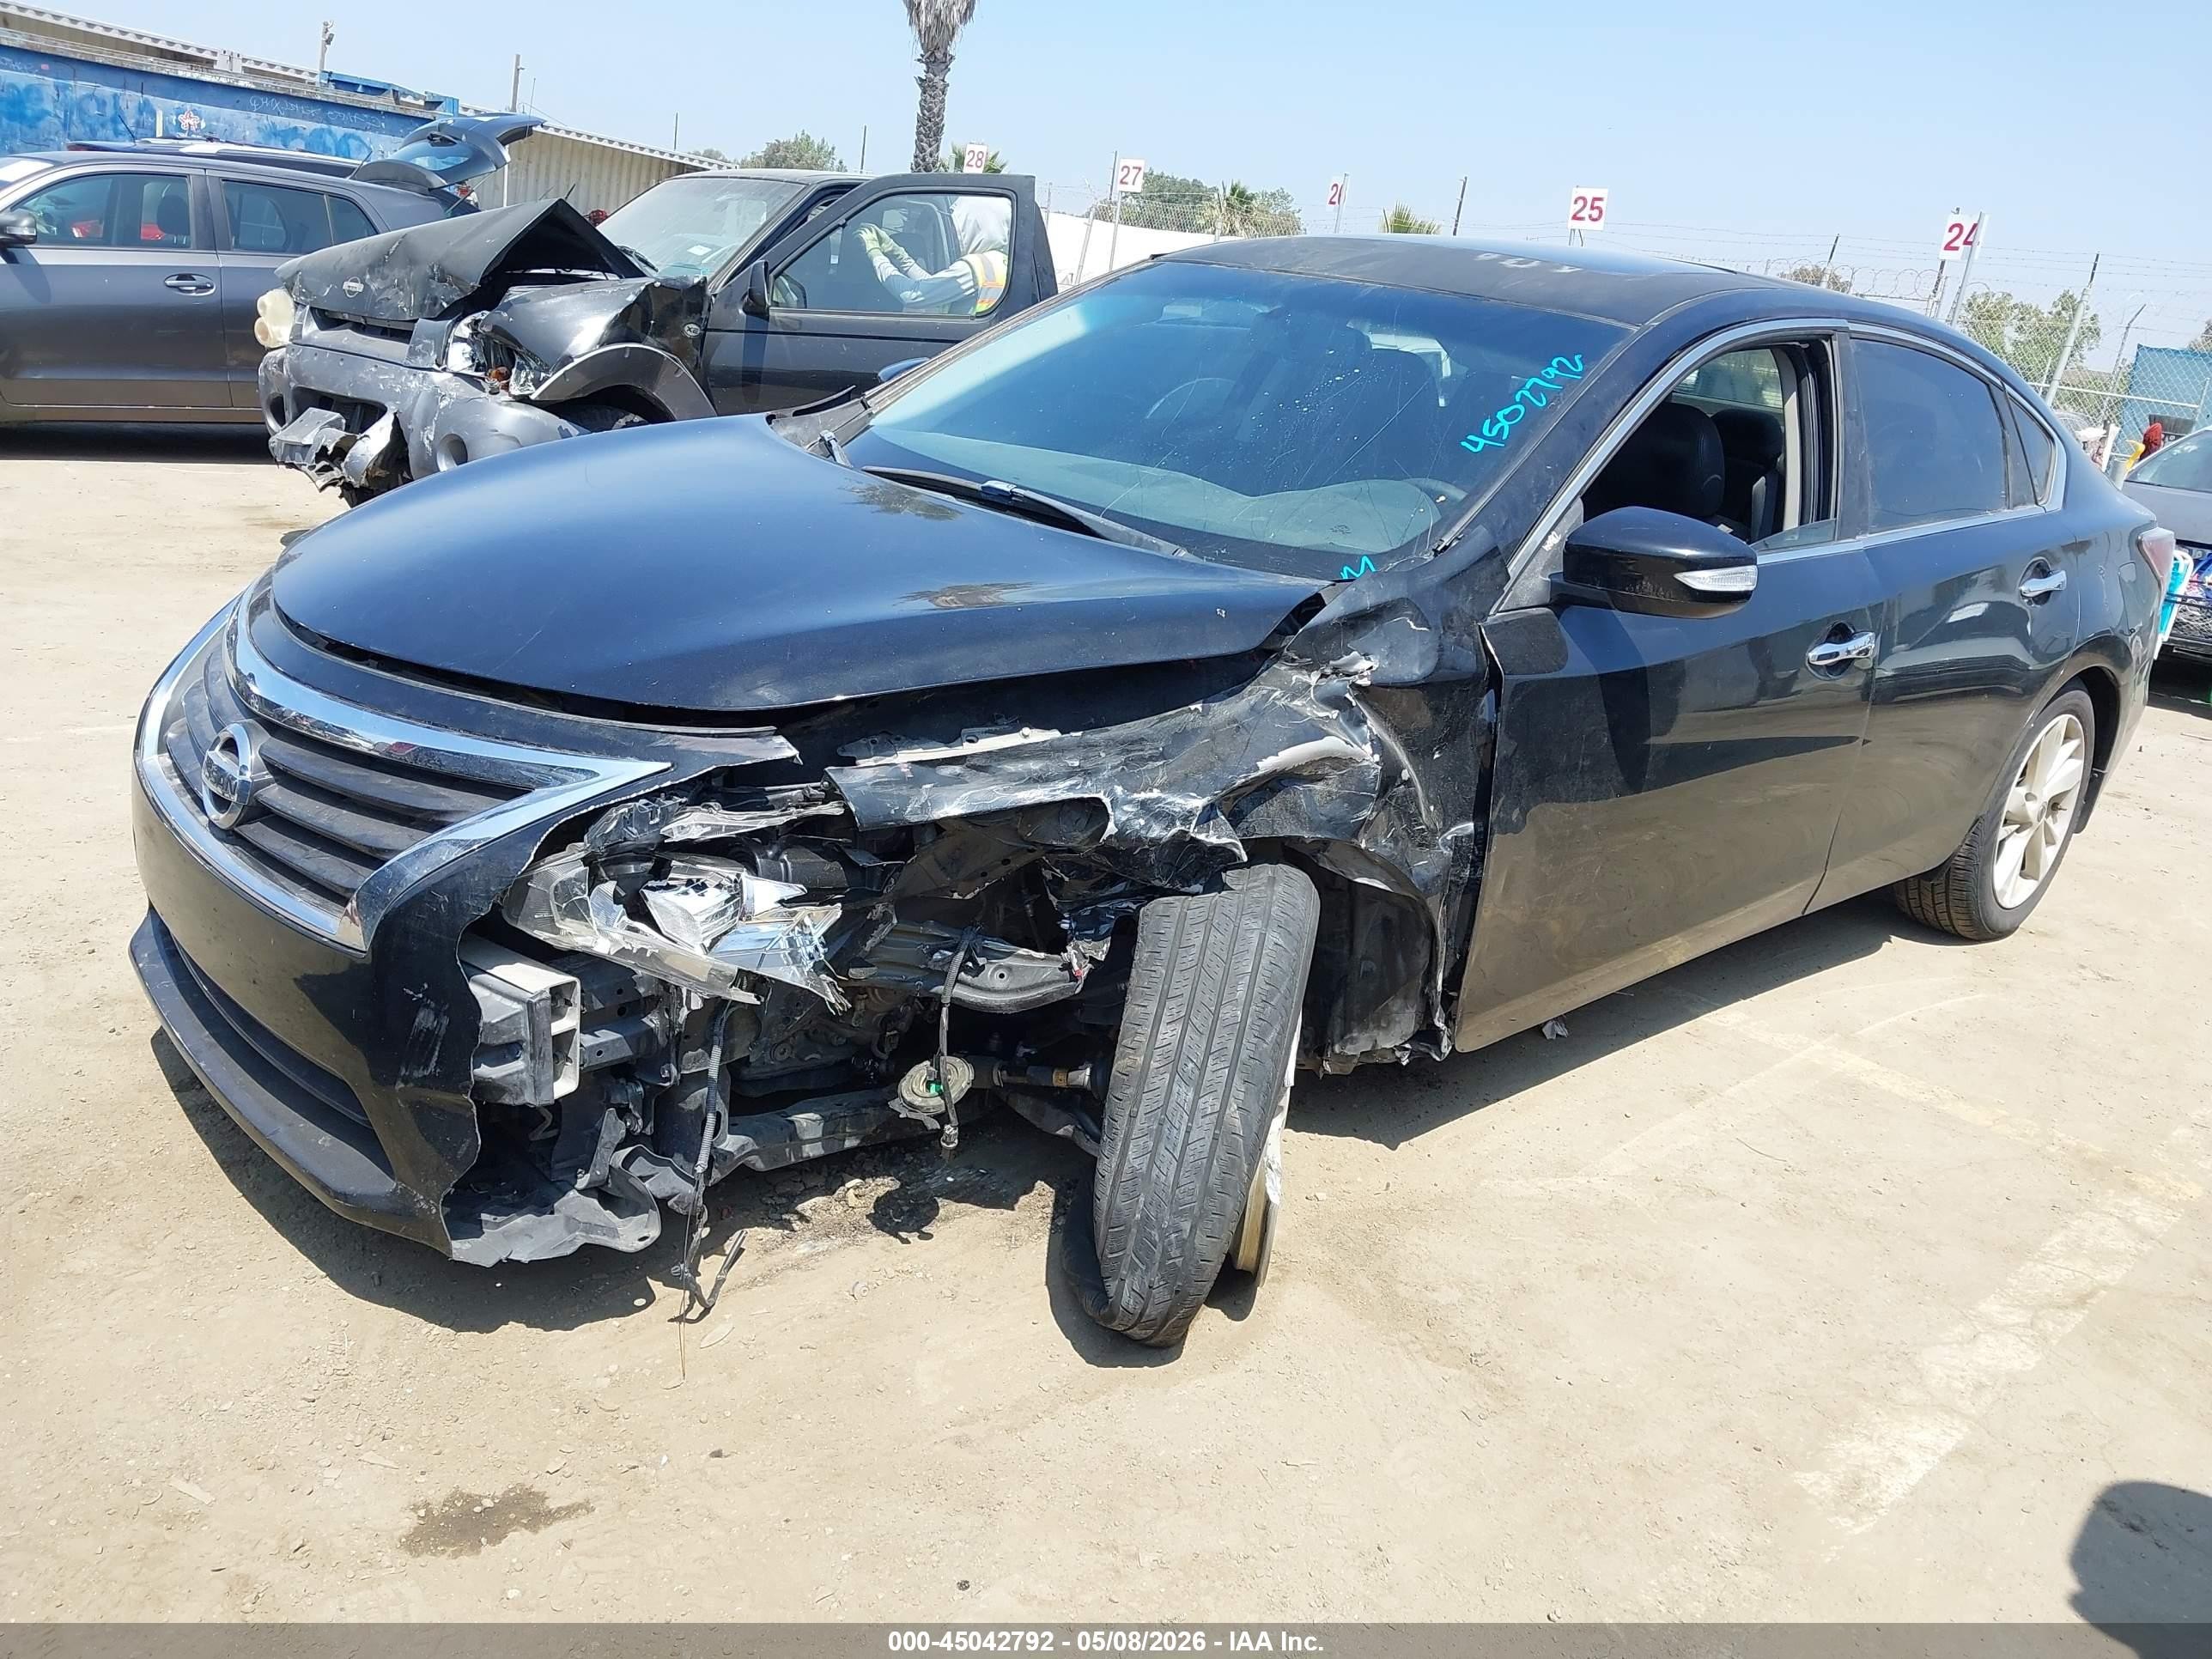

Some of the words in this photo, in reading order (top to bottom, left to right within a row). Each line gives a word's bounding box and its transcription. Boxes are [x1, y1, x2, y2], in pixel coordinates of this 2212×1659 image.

[966, 149, 985, 169] 28
[1119, 165, 1142, 186] 27
[1571, 196, 1605, 222] 25
[1460, 353, 1584, 453] 4502792
